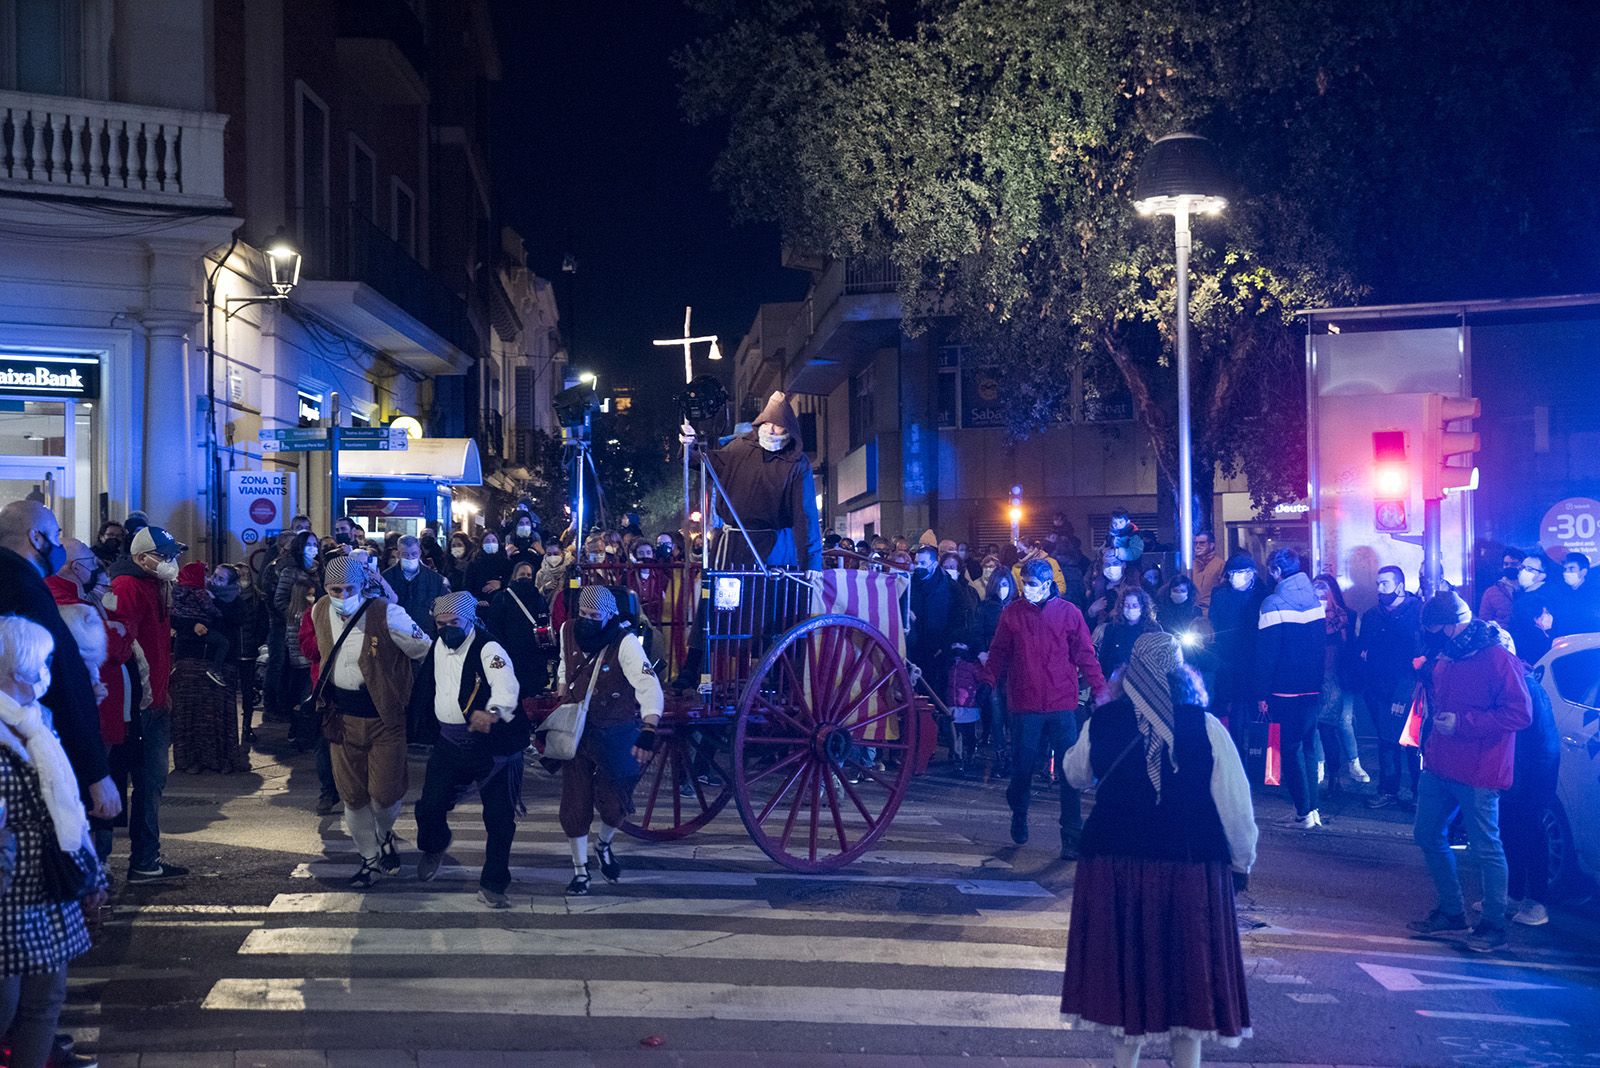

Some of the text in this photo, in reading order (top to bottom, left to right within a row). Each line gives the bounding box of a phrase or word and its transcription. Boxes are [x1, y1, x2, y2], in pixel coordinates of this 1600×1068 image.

[241, 476, 287, 485] ZONA DE
[238, 487, 287, 495] VIANANTS
